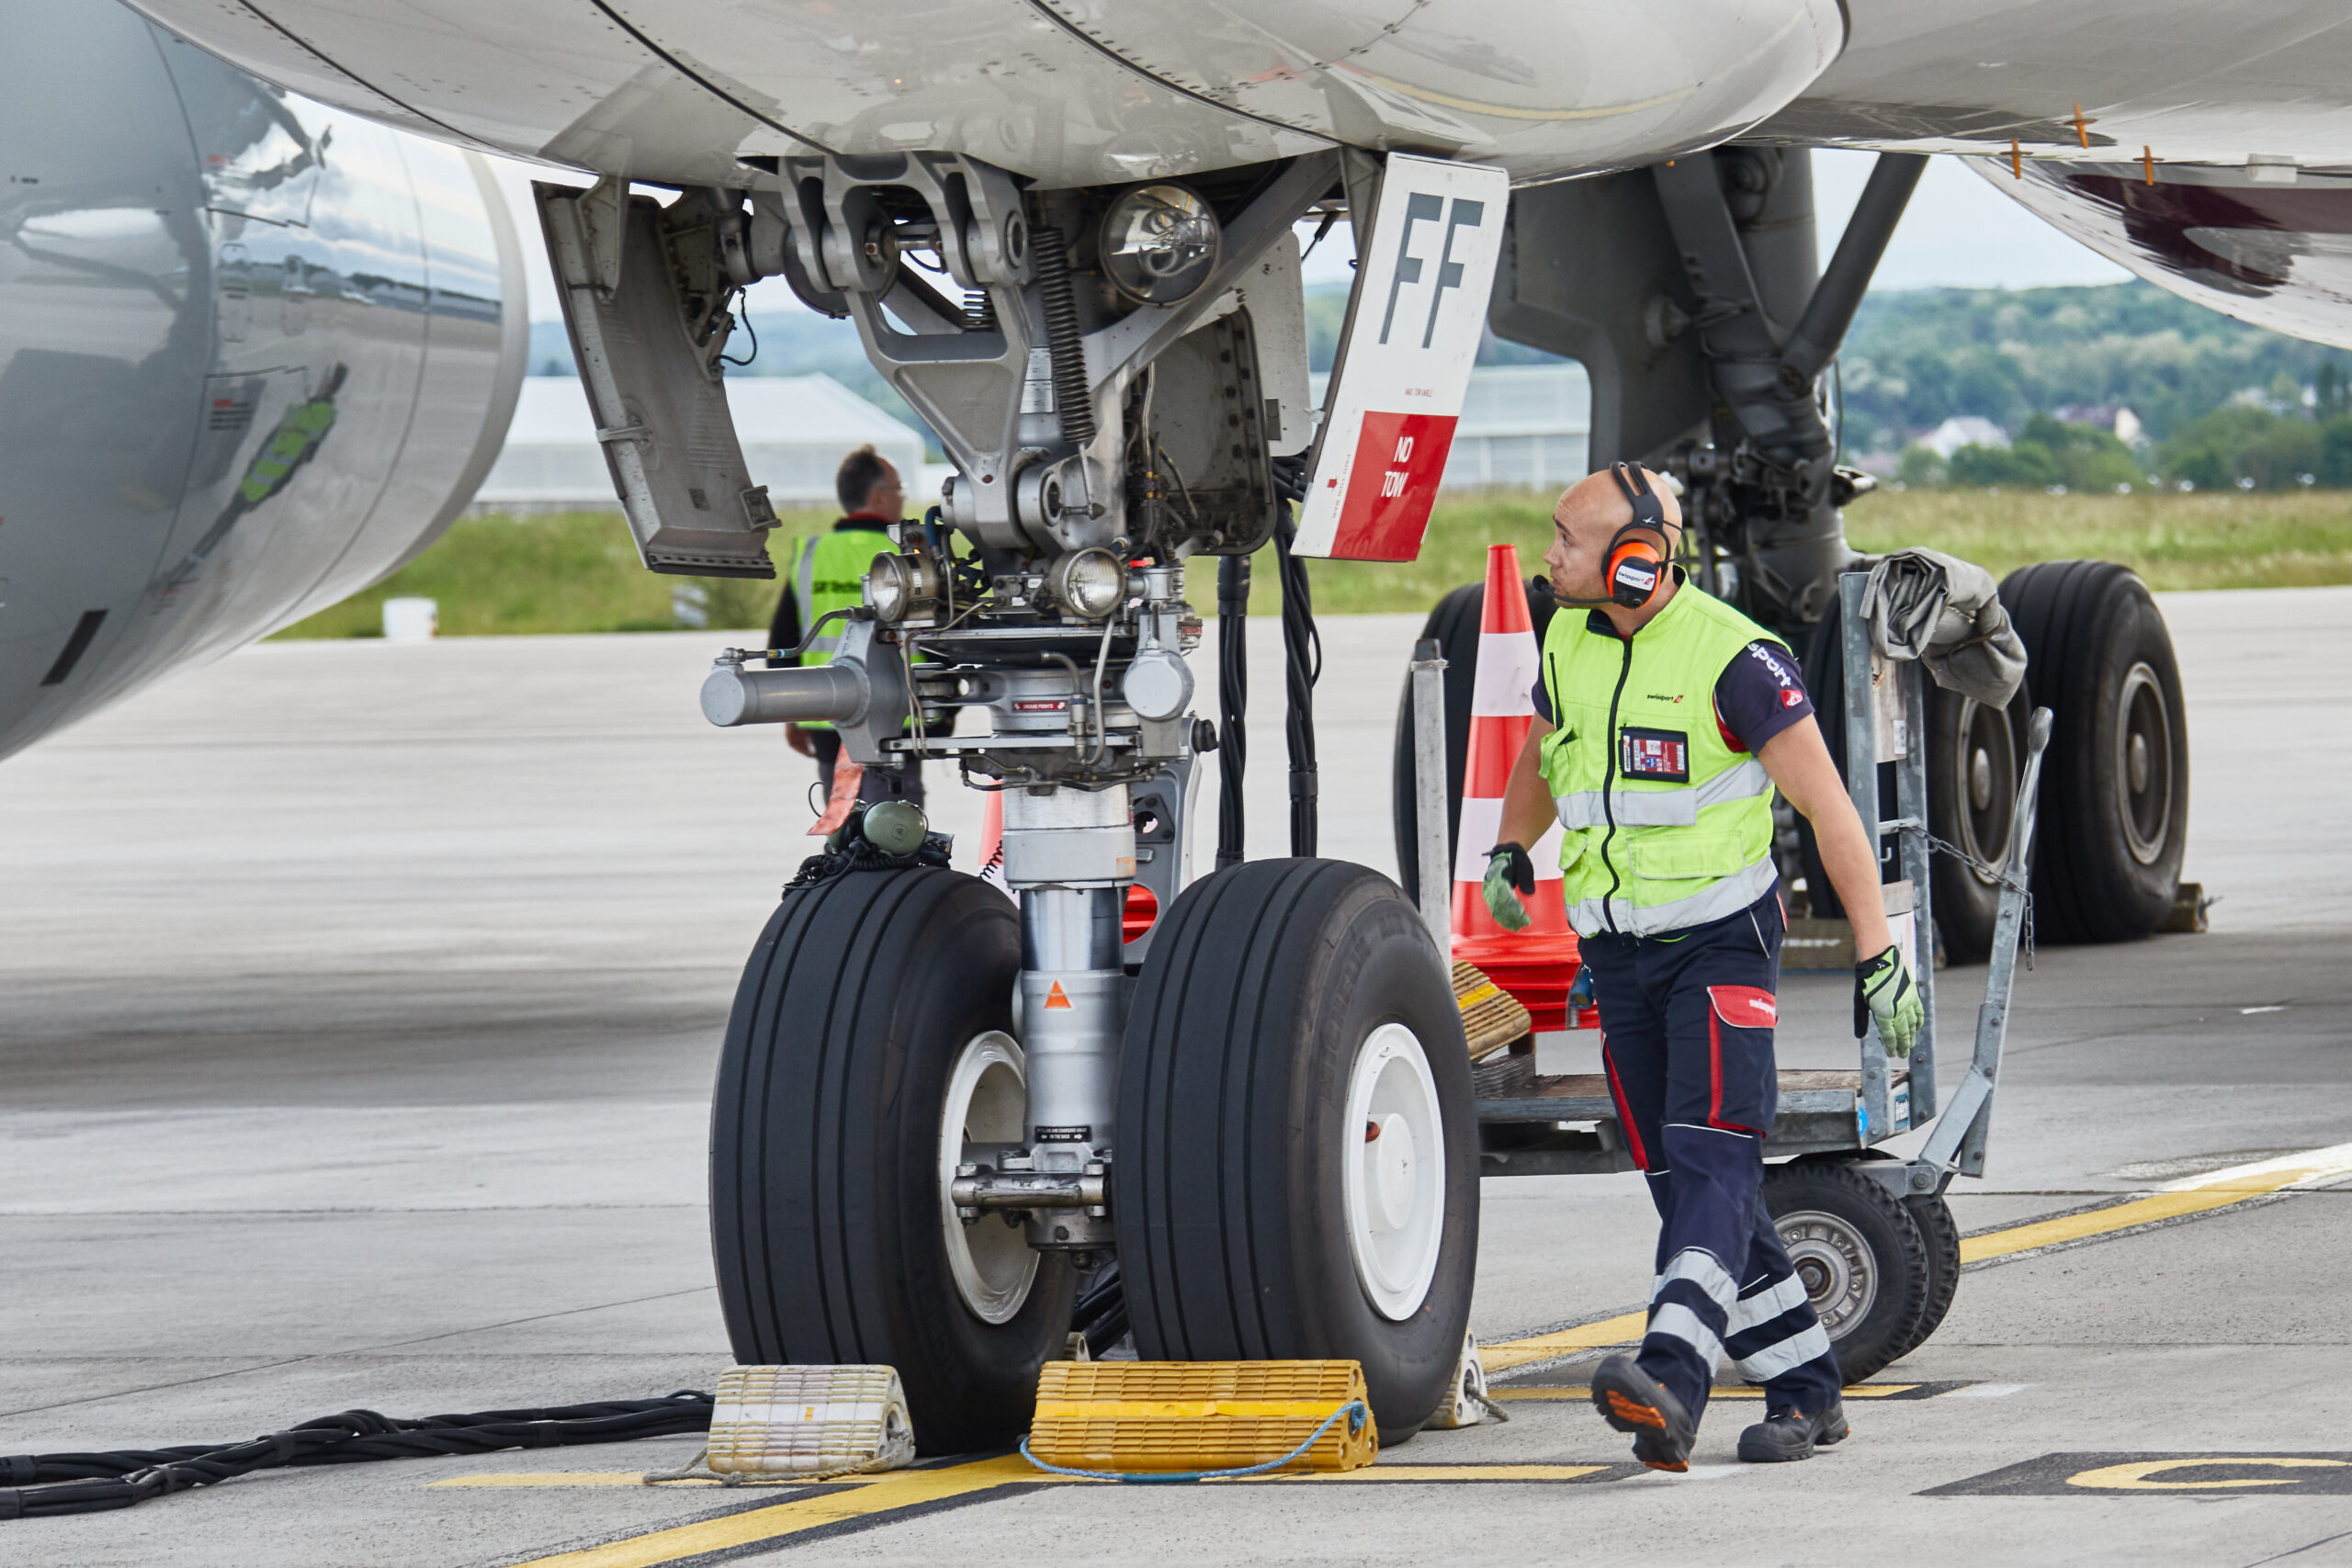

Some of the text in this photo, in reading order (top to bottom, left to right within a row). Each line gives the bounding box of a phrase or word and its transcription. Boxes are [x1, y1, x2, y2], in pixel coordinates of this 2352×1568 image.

[1379, 192, 1485, 349] FF
[1393, 435, 1414, 463] NO
[1380, 470, 1410, 498] TOW
